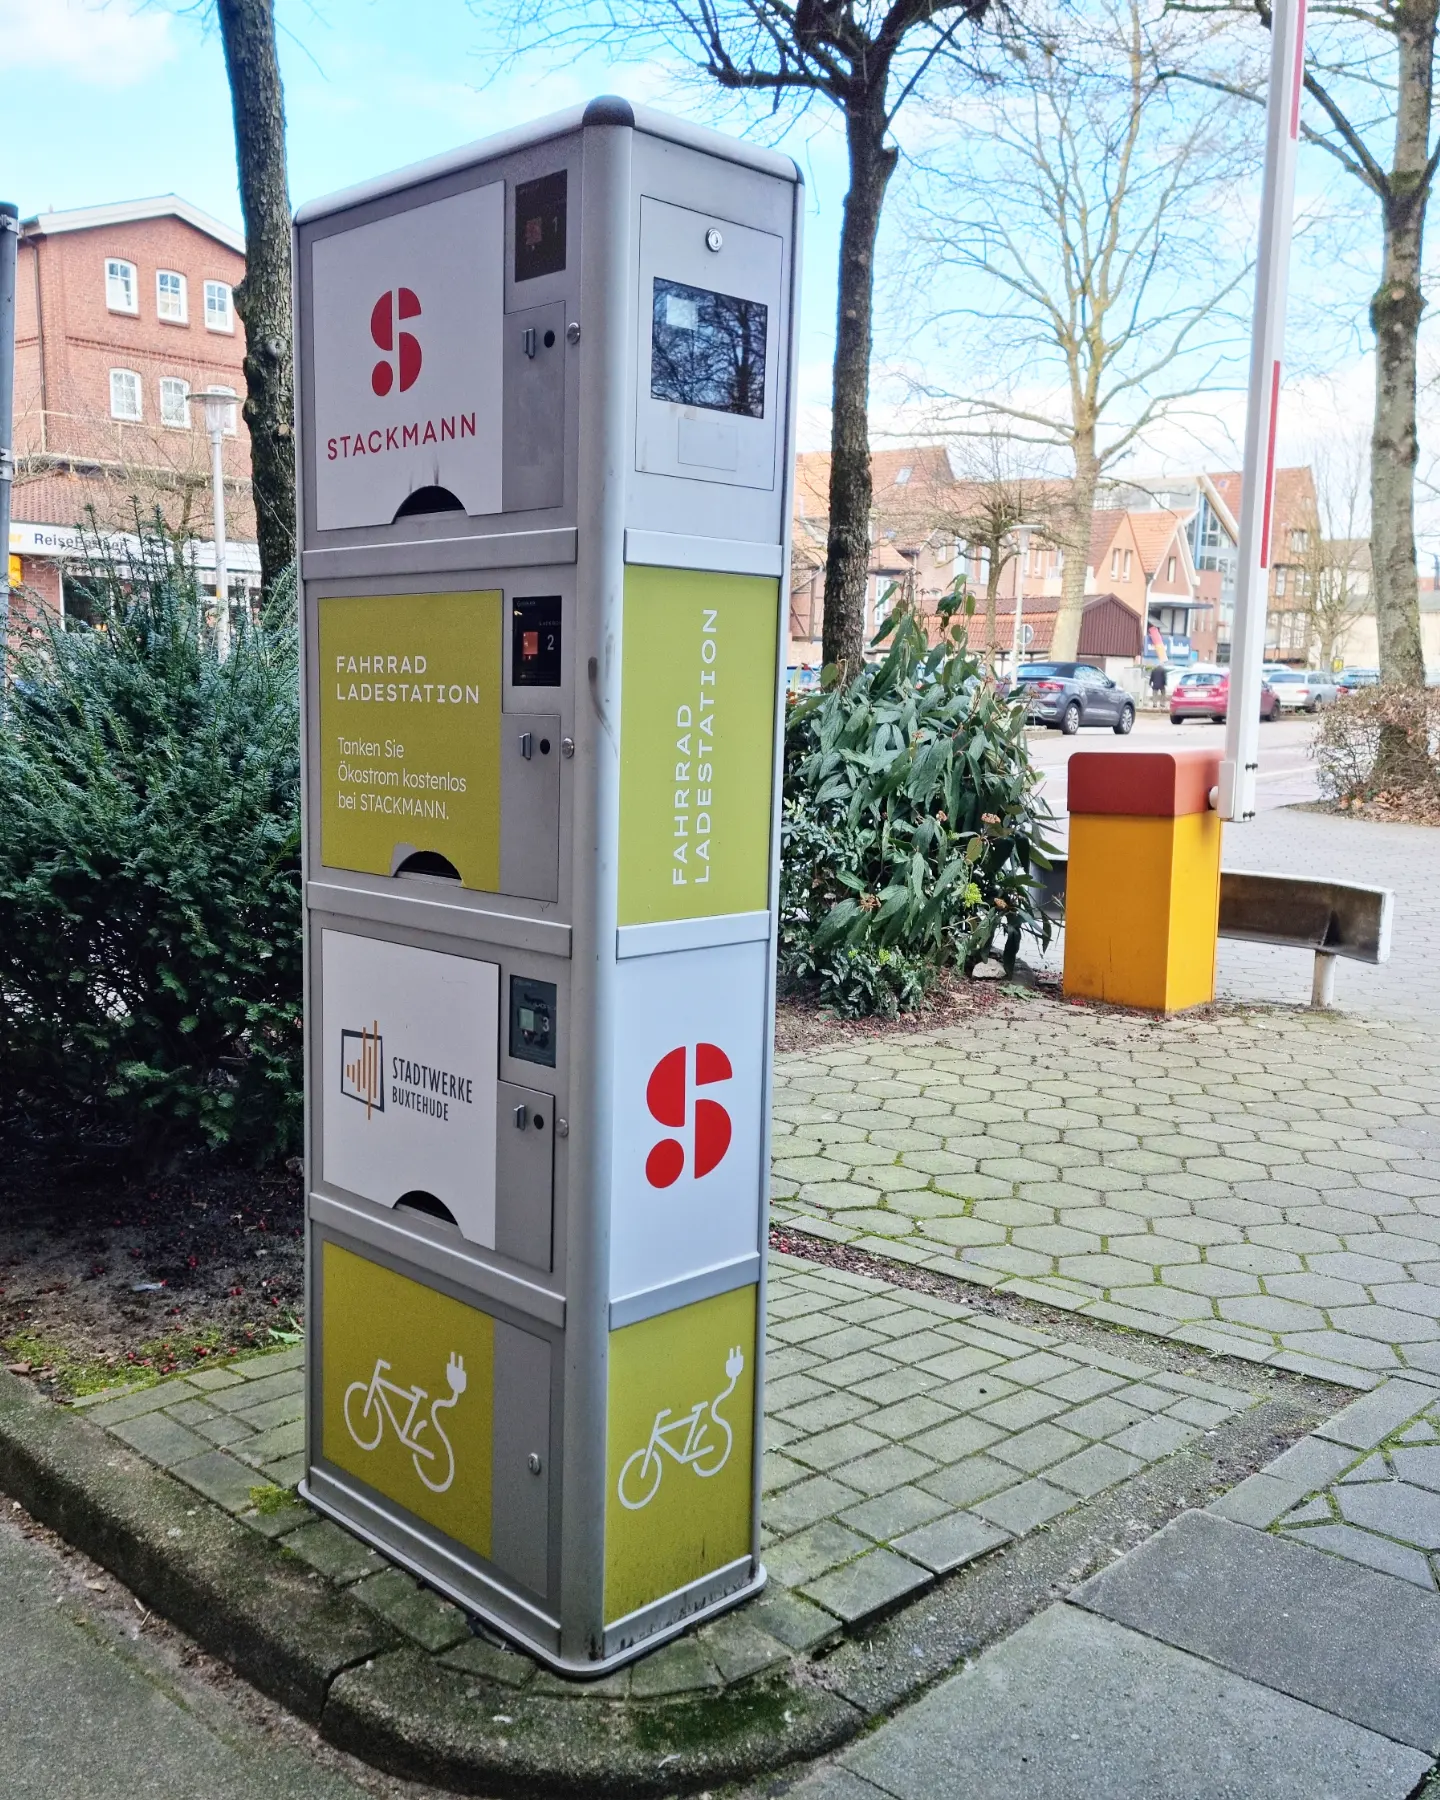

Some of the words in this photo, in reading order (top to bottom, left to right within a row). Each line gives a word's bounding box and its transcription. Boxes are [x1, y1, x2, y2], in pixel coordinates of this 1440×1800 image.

[327, 412, 476, 461] STACKMANN
[34, 533, 125, 551] ReisePaner
[547, 634, 554, 651] 2
[336, 655, 427, 674] FAHRRAD
[336, 683, 479, 704] LADESTATION
[338, 737, 380, 757] Tanken
[385, 739, 404, 758] Sie
[695, 609, 718, 883] LADESTATION
[338, 760, 399, 786] Ökostrom
[403, 767, 467, 793] kostenlos
[338, 790, 356, 810] bei
[360, 793, 450, 820] STACKMANN.
[672, 704, 692, 885] FAHRRAD
[542, 1016, 550, 1032] 3
[392, 1056, 473, 1104] STADTWERKE
[392, 1085, 449, 1121] BUXTEHUDE
